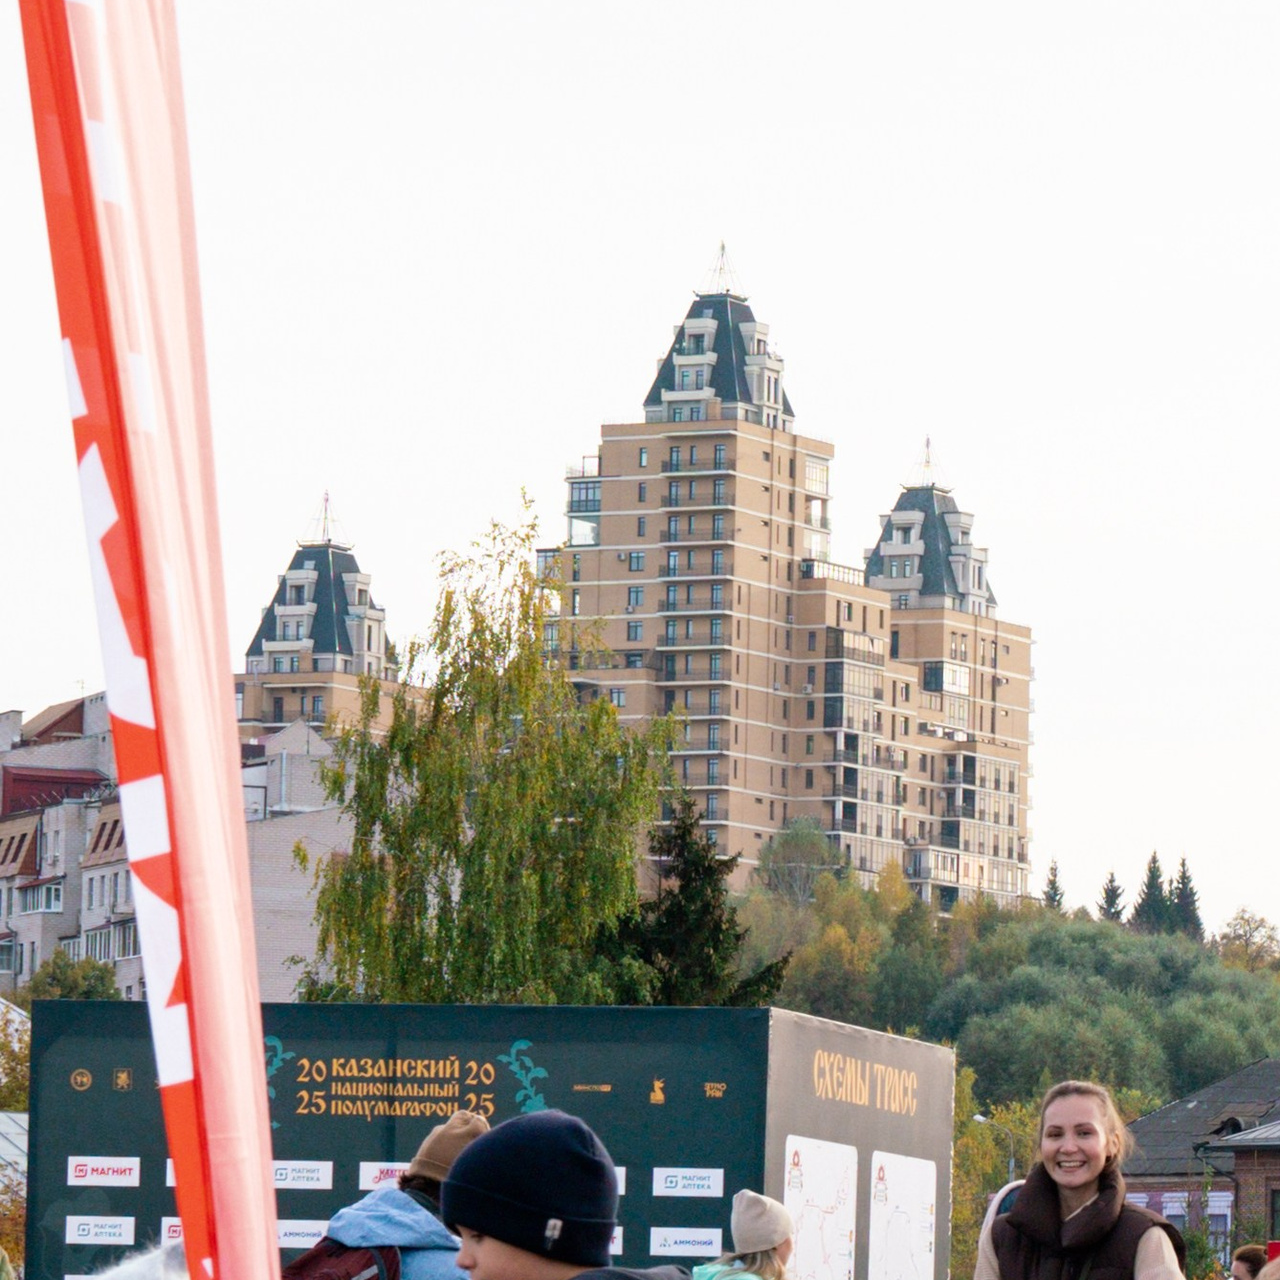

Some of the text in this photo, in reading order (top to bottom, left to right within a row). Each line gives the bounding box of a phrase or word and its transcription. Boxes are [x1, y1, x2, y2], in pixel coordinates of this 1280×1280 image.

[297, 1055, 495, 1085] 20 КАЗАНСКИЙ 20
[331, 1081, 460, 1097] НАЦИОНАЛЬНЫЙ
[813, 1049, 918, 1117] СХЕМЫ ТРАСС
[296, 1090, 495, 1121] 25 ПОЛУМАРАФОН 25
[91, 1167, 134, 1177] МАГНИТ
[283, 1230, 323, 1239] АММОНИЙ
[673, 1238, 714, 1246] АММОНИЙ
